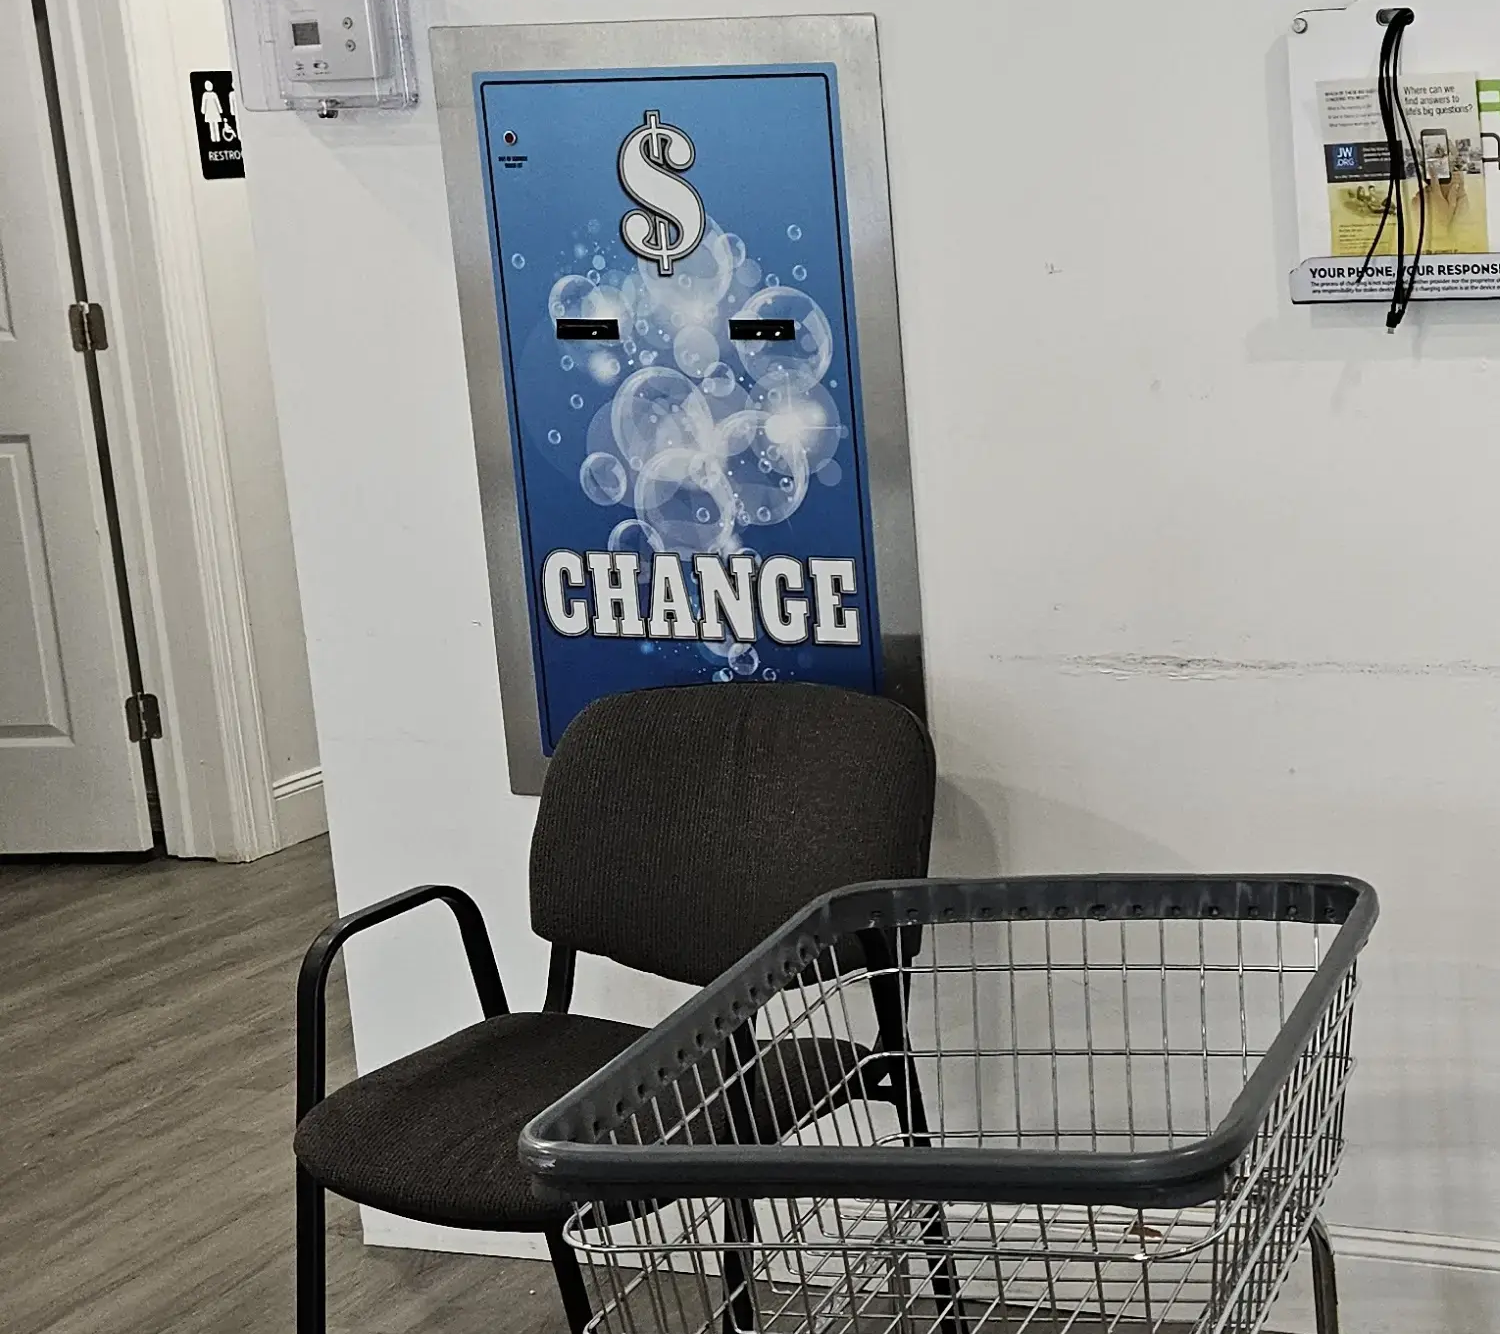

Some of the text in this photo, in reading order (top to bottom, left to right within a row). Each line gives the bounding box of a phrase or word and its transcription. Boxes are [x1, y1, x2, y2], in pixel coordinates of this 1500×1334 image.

[1404, 87, 1427, 95] Where
[1429, 86, 1442, 94] can
[1405, 94, 1459, 105] find answers to
[1423, 106, 1434, 116] big
[1436, 104, 1473, 115] questions?
[1337, 147, 1352, 158] JW
[1310, 268, 1345, 278] YOUR
[542, 547, 862, 646] CHANGE
